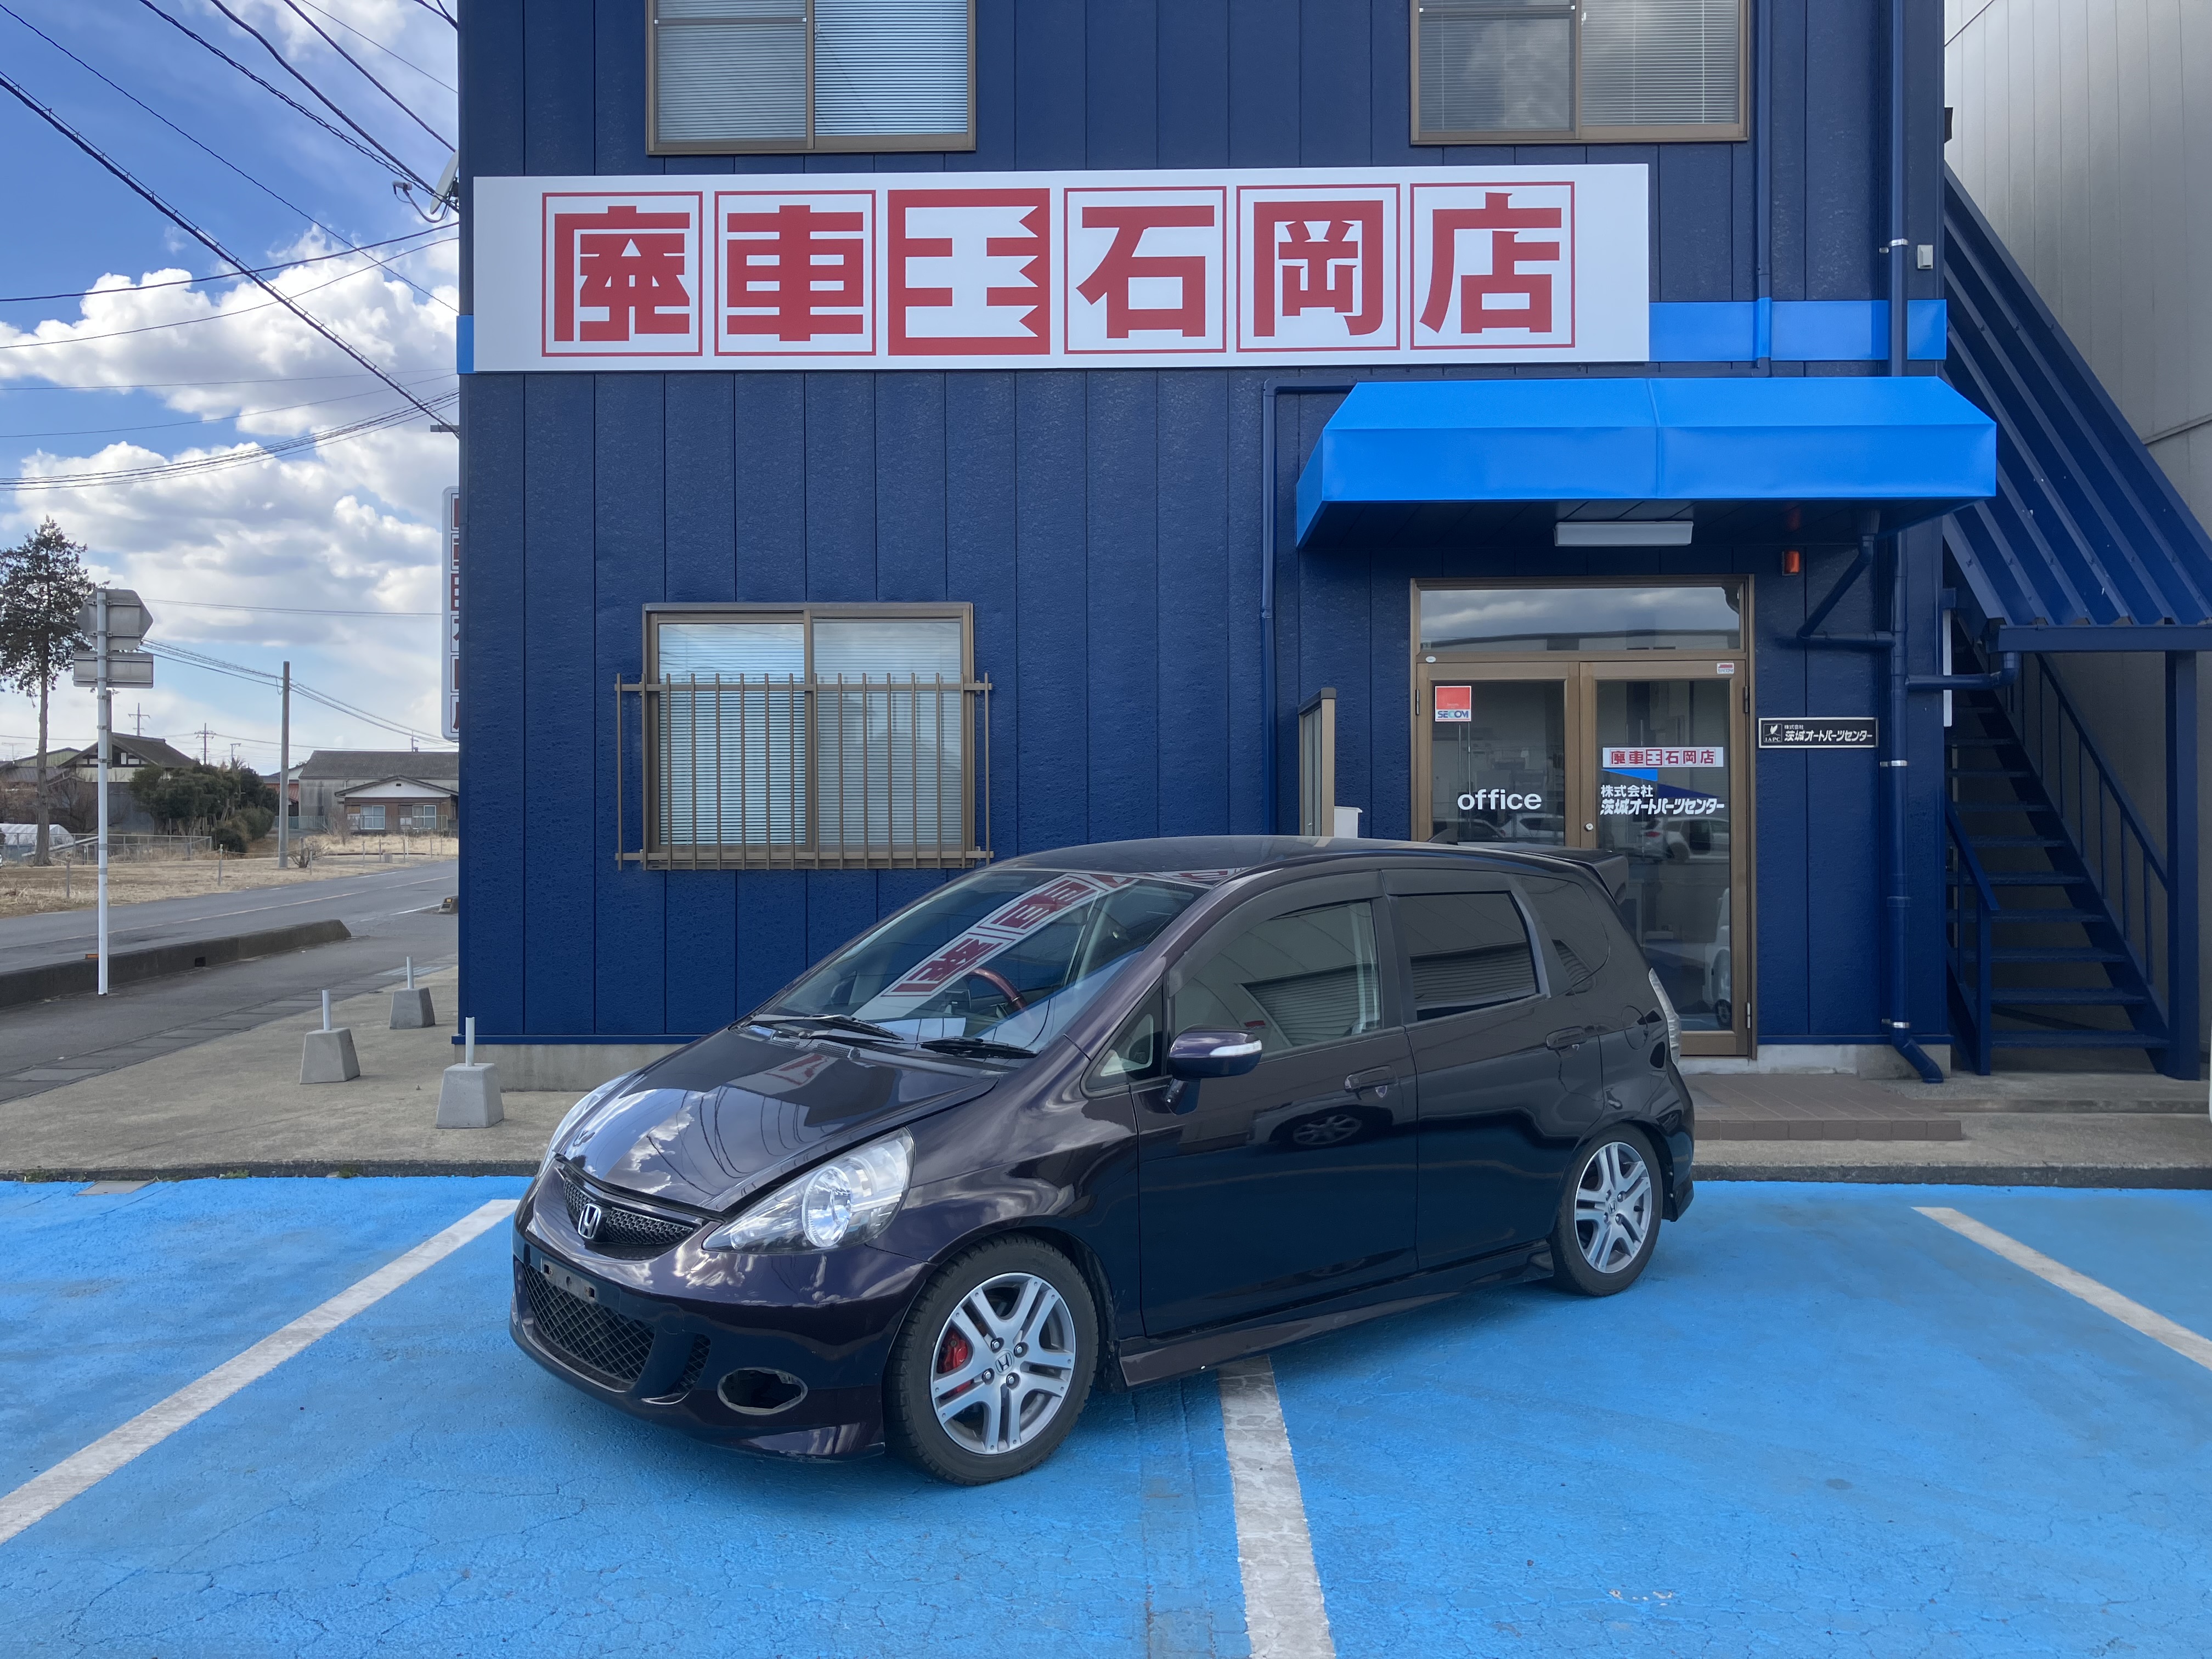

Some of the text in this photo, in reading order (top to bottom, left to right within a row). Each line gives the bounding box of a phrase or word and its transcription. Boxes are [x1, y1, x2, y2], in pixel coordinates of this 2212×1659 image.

[1784, 730, 1873, 742] 茨城オートパーツセンター
[1457, 788, 1542, 810] office
[1600, 785, 1654, 798] 株式会社
[1600, 798, 1725, 815] 茨城オートパーツセンター
